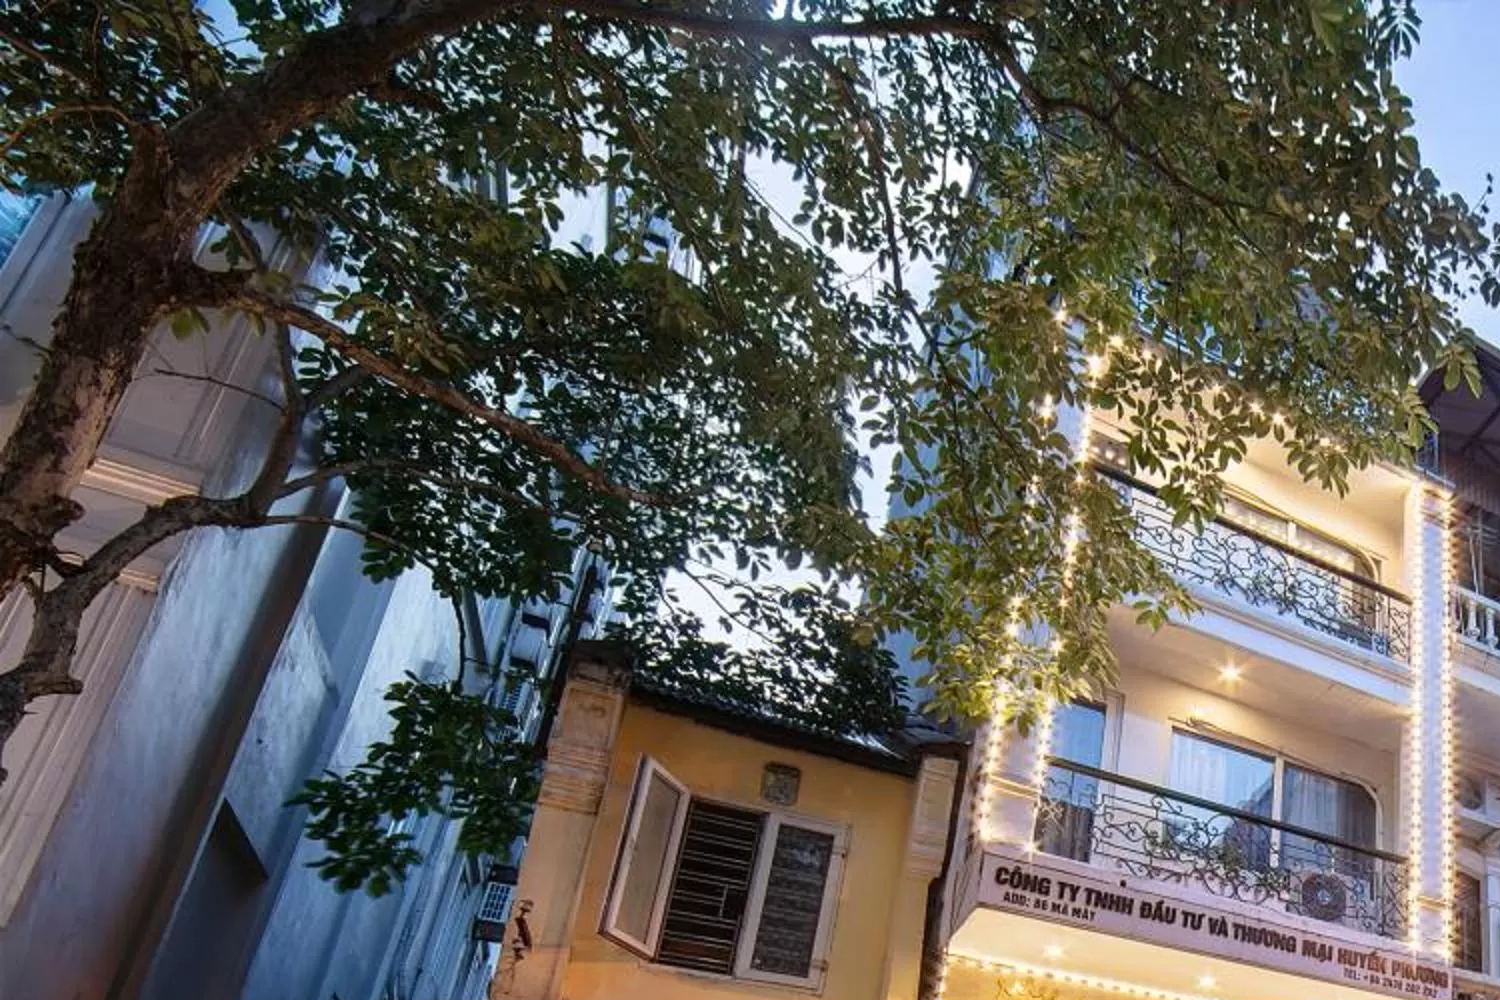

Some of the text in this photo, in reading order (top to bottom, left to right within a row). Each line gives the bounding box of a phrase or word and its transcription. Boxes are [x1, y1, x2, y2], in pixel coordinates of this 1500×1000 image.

[994, 865, 1051, 898] CÔNG
[1056, 881, 1082, 903] TY
[1082, 887, 1135, 917] TNHH
